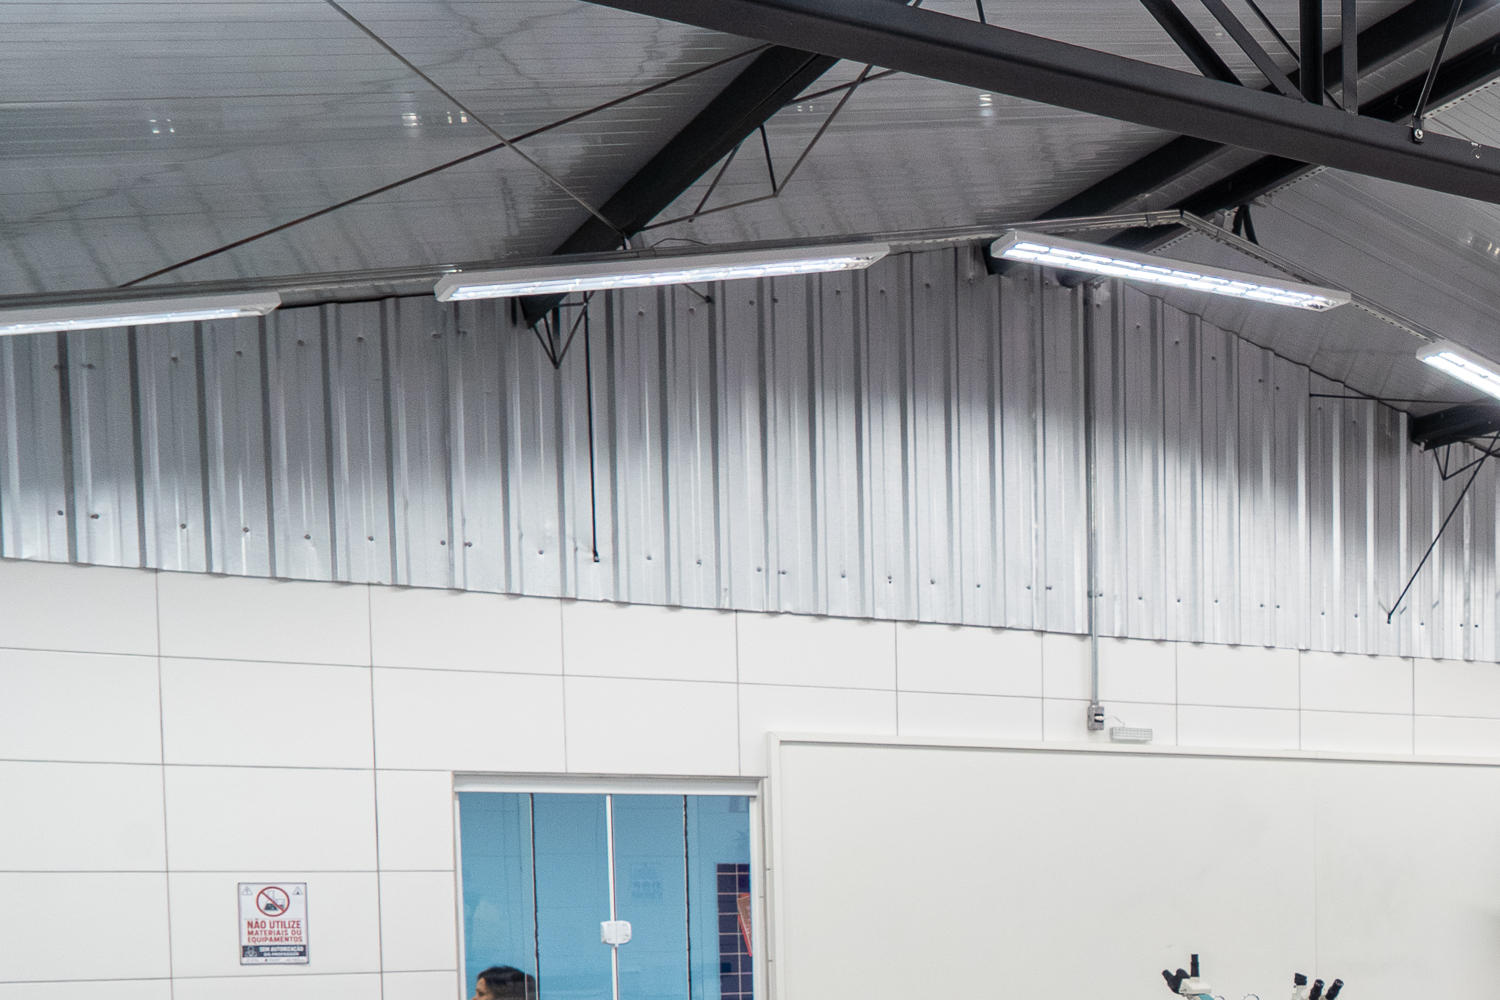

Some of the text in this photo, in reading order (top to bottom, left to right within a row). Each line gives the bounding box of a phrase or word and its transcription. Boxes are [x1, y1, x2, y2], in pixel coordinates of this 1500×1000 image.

[247, 918, 301, 929] NÃO UTILIZE
[247, 936, 303, 944] EQUIPAMENTOS
